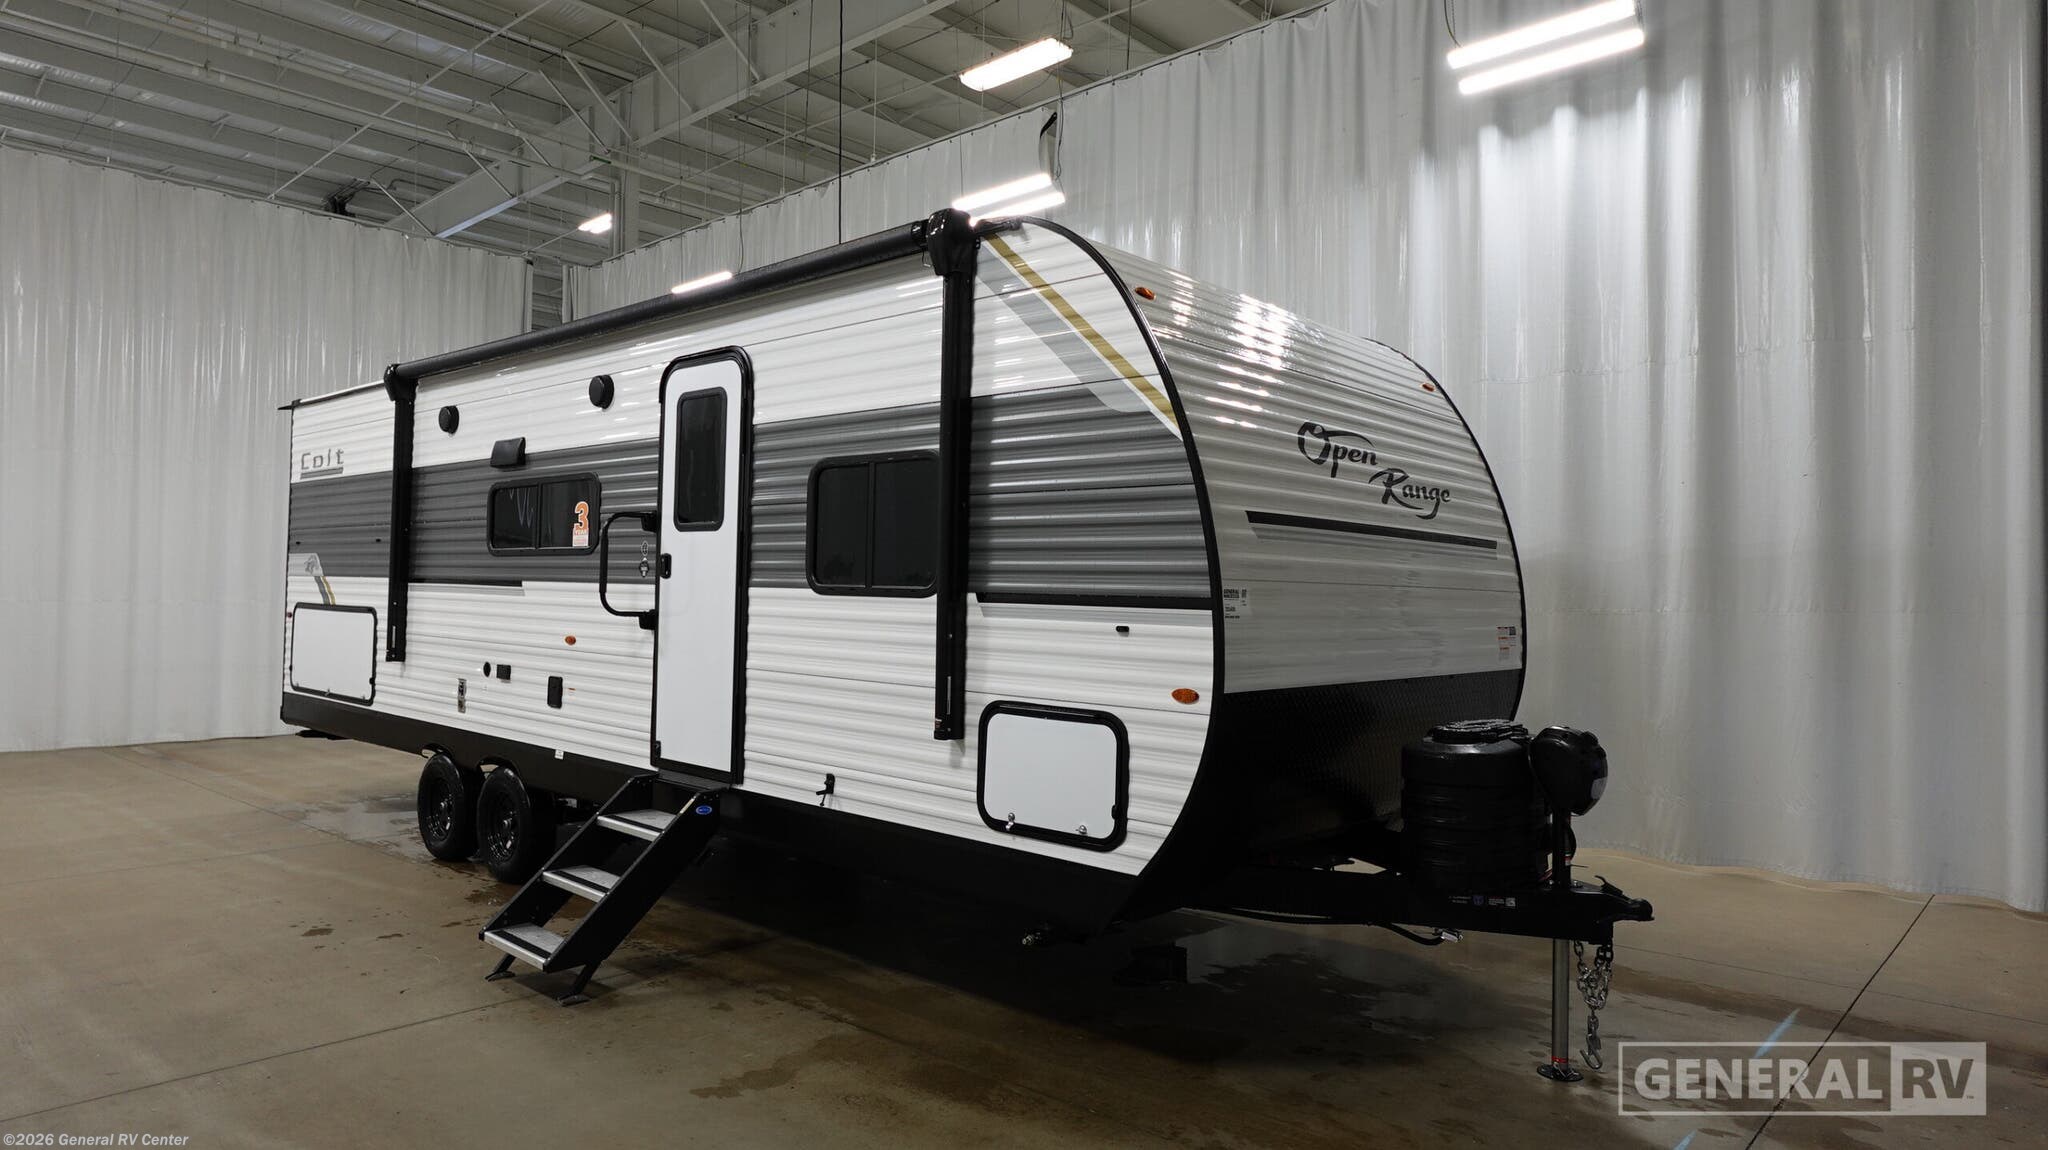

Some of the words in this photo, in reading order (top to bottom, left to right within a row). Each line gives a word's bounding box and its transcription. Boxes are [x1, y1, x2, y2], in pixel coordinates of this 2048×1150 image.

[301, 449, 344, 470] Colt
[1297, 421, 1378, 478] Open
[1368, 468, 1451, 520] Range
[575, 501, 589, 530] 3
